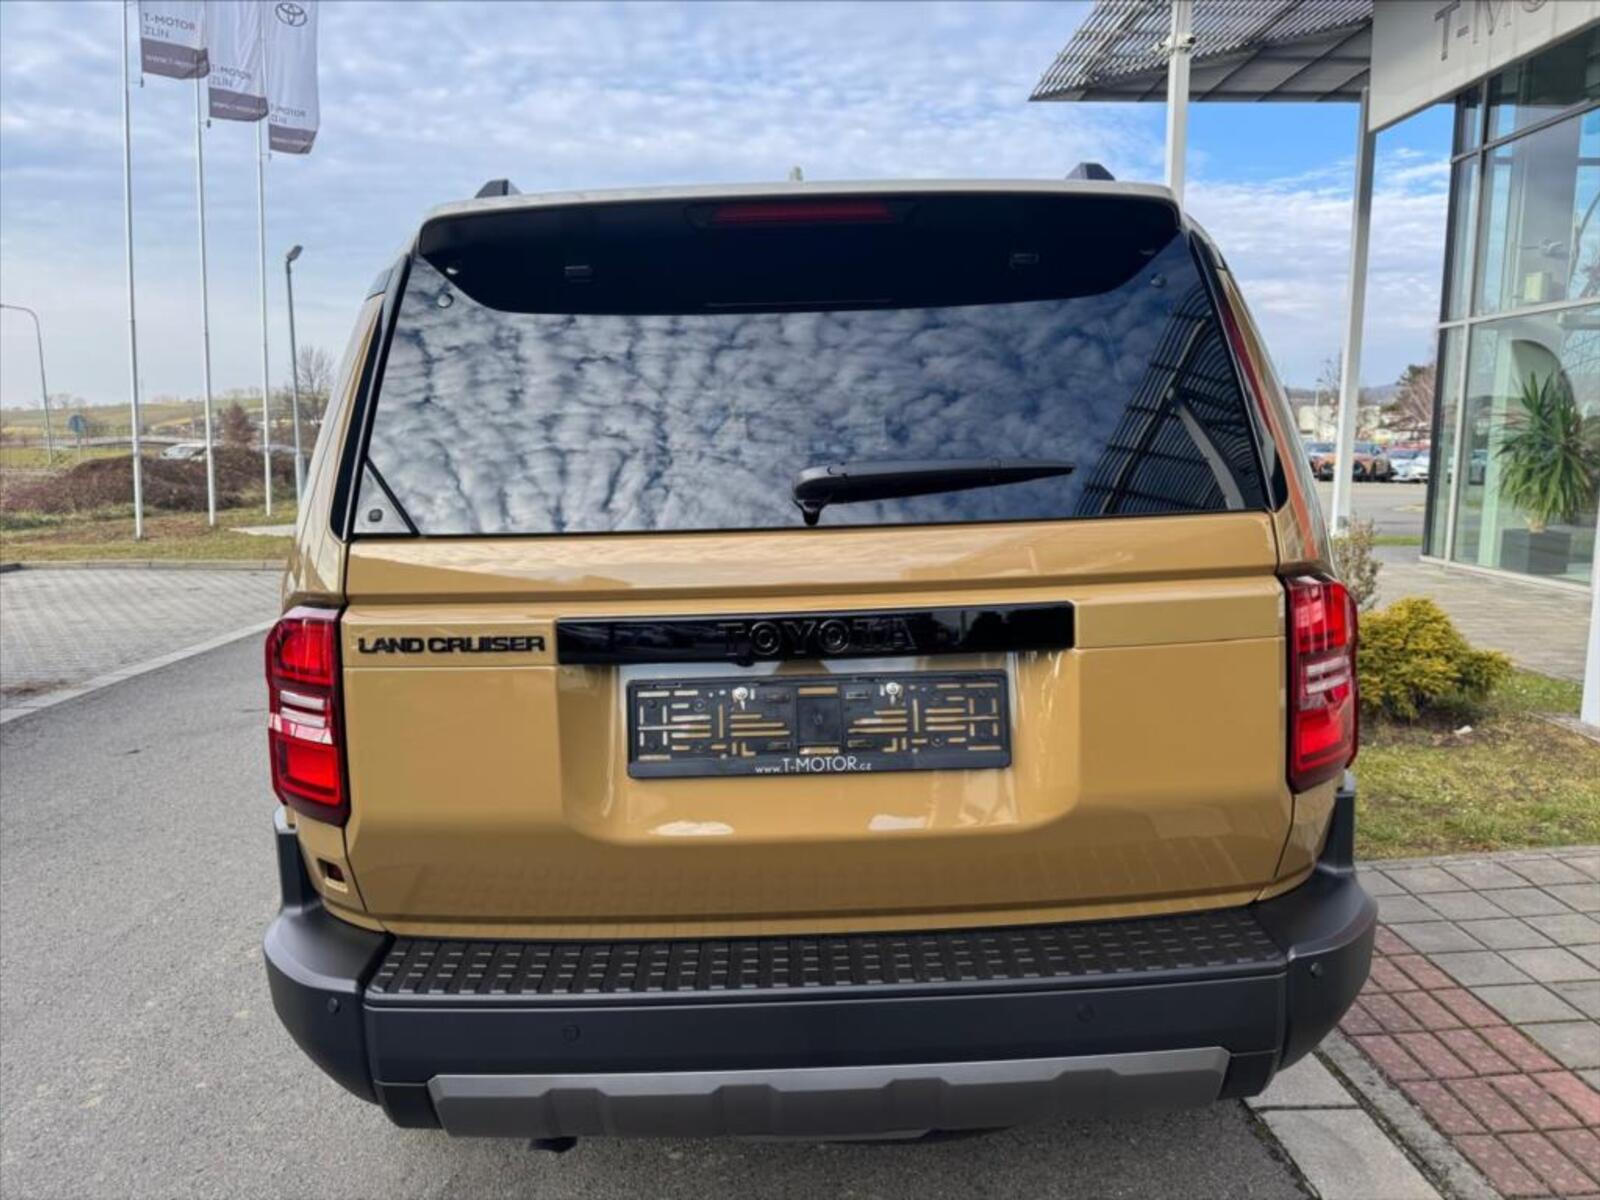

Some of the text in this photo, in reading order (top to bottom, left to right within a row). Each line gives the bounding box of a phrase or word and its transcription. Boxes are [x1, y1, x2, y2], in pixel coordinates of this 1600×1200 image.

[144, 12, 195, 31] T-MOTOR
[358, 636, 545, 654] LAND CRUISER
[718, 618, 917, 656] TOYOTA
[755, 755, 872, 773] www.T-MOTOR.cz
